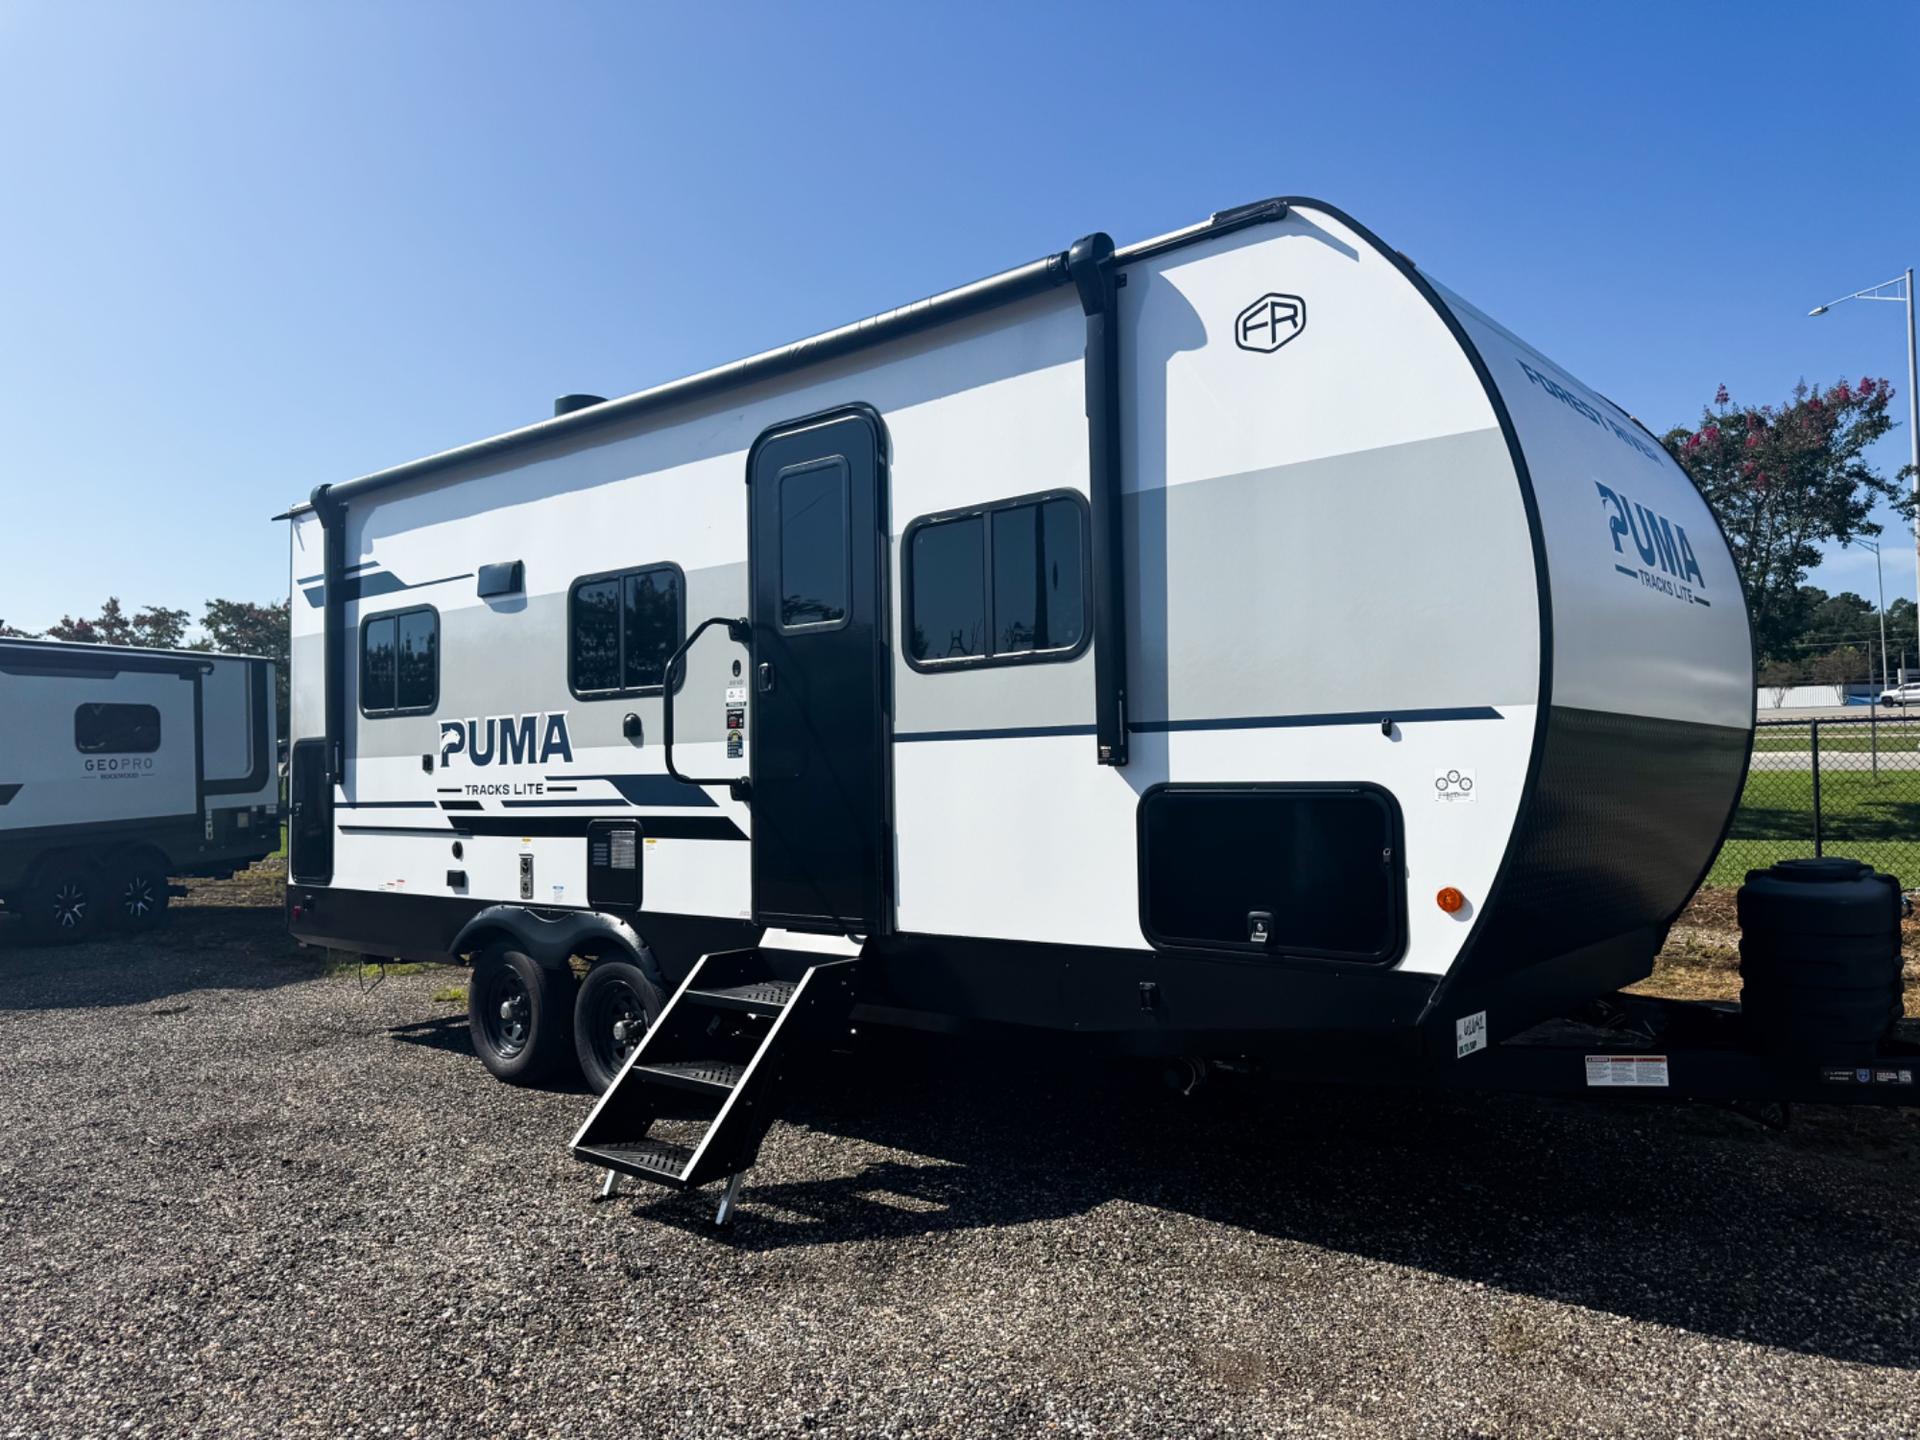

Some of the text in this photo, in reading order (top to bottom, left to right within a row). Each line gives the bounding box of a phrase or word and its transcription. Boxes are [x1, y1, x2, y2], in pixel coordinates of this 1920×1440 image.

[1594, 480, 1705, 589] PUMA
[1638, 568, 1694, 604] TRACKS LITE
[439, 712, 574, 768] PUMA
[465, 783, 544, 796] TRACKS LITE
